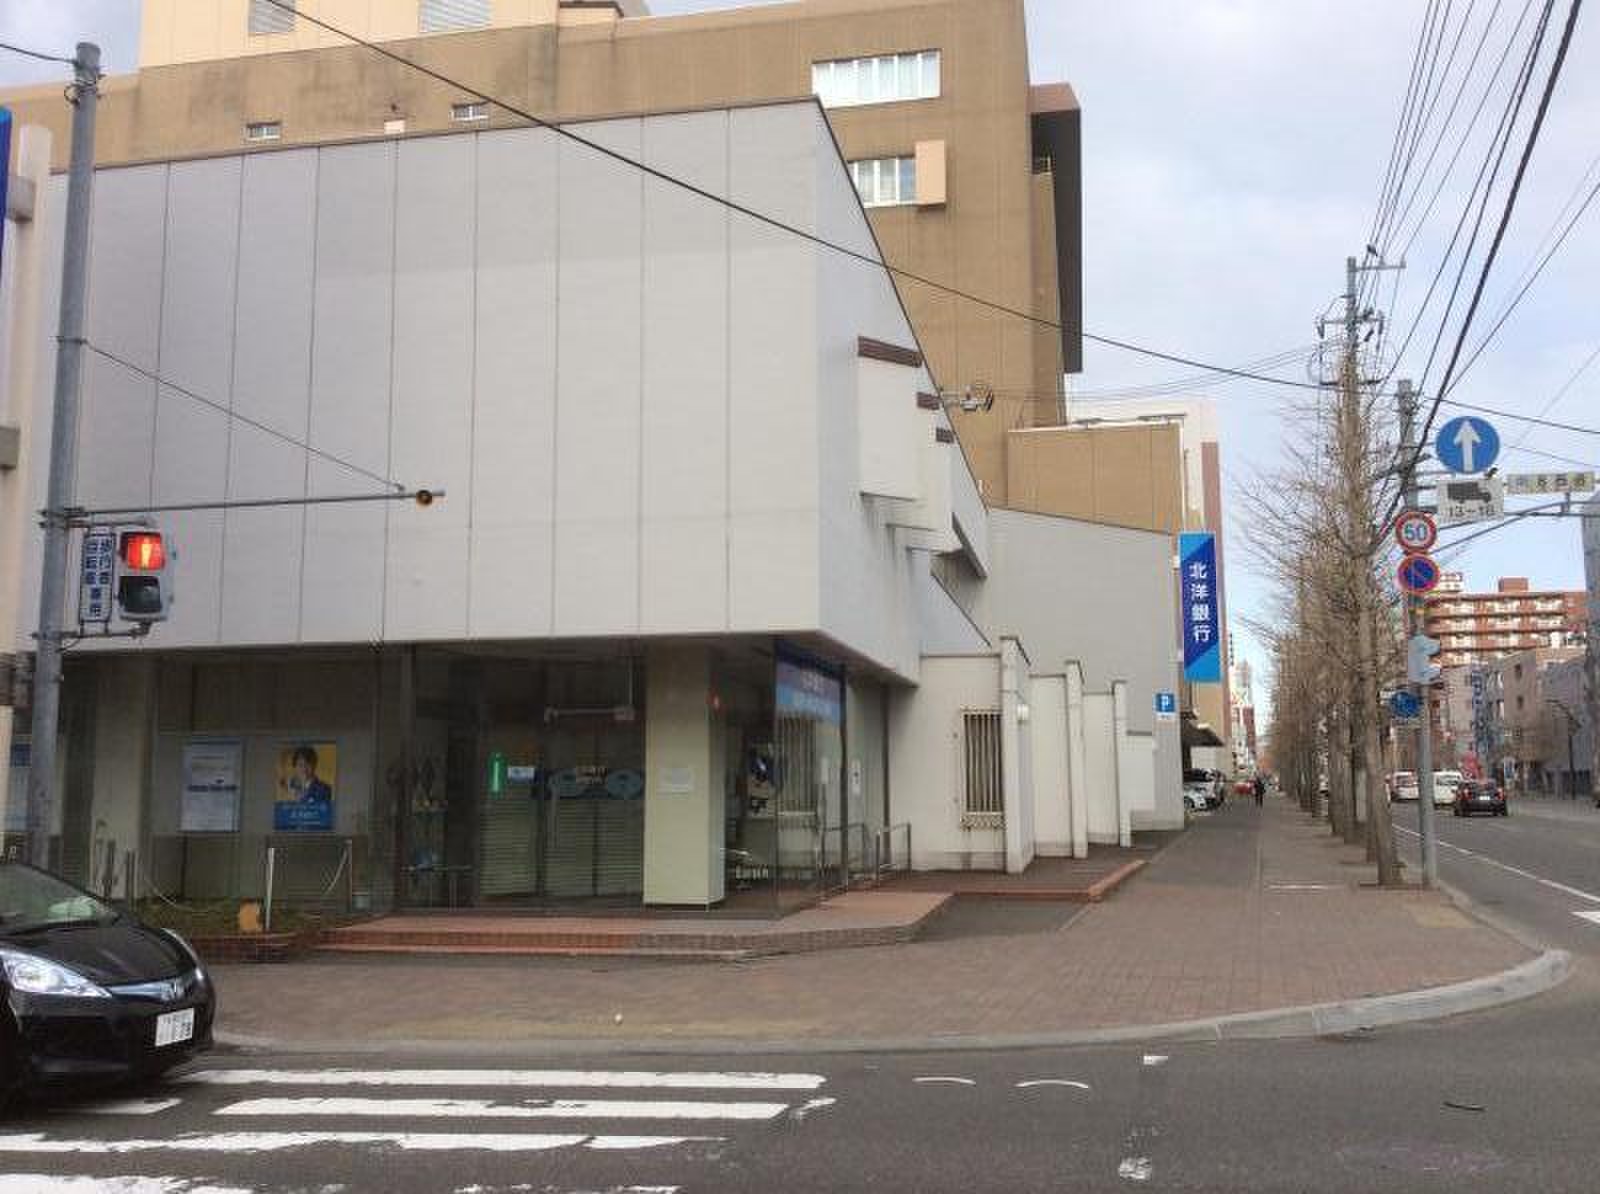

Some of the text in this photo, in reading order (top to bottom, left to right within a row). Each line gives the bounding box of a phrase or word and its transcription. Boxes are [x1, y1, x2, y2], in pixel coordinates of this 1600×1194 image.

[1404, 523, 1428, 541] 50
[1189, 560, 1211, 643] 北洋銀行
